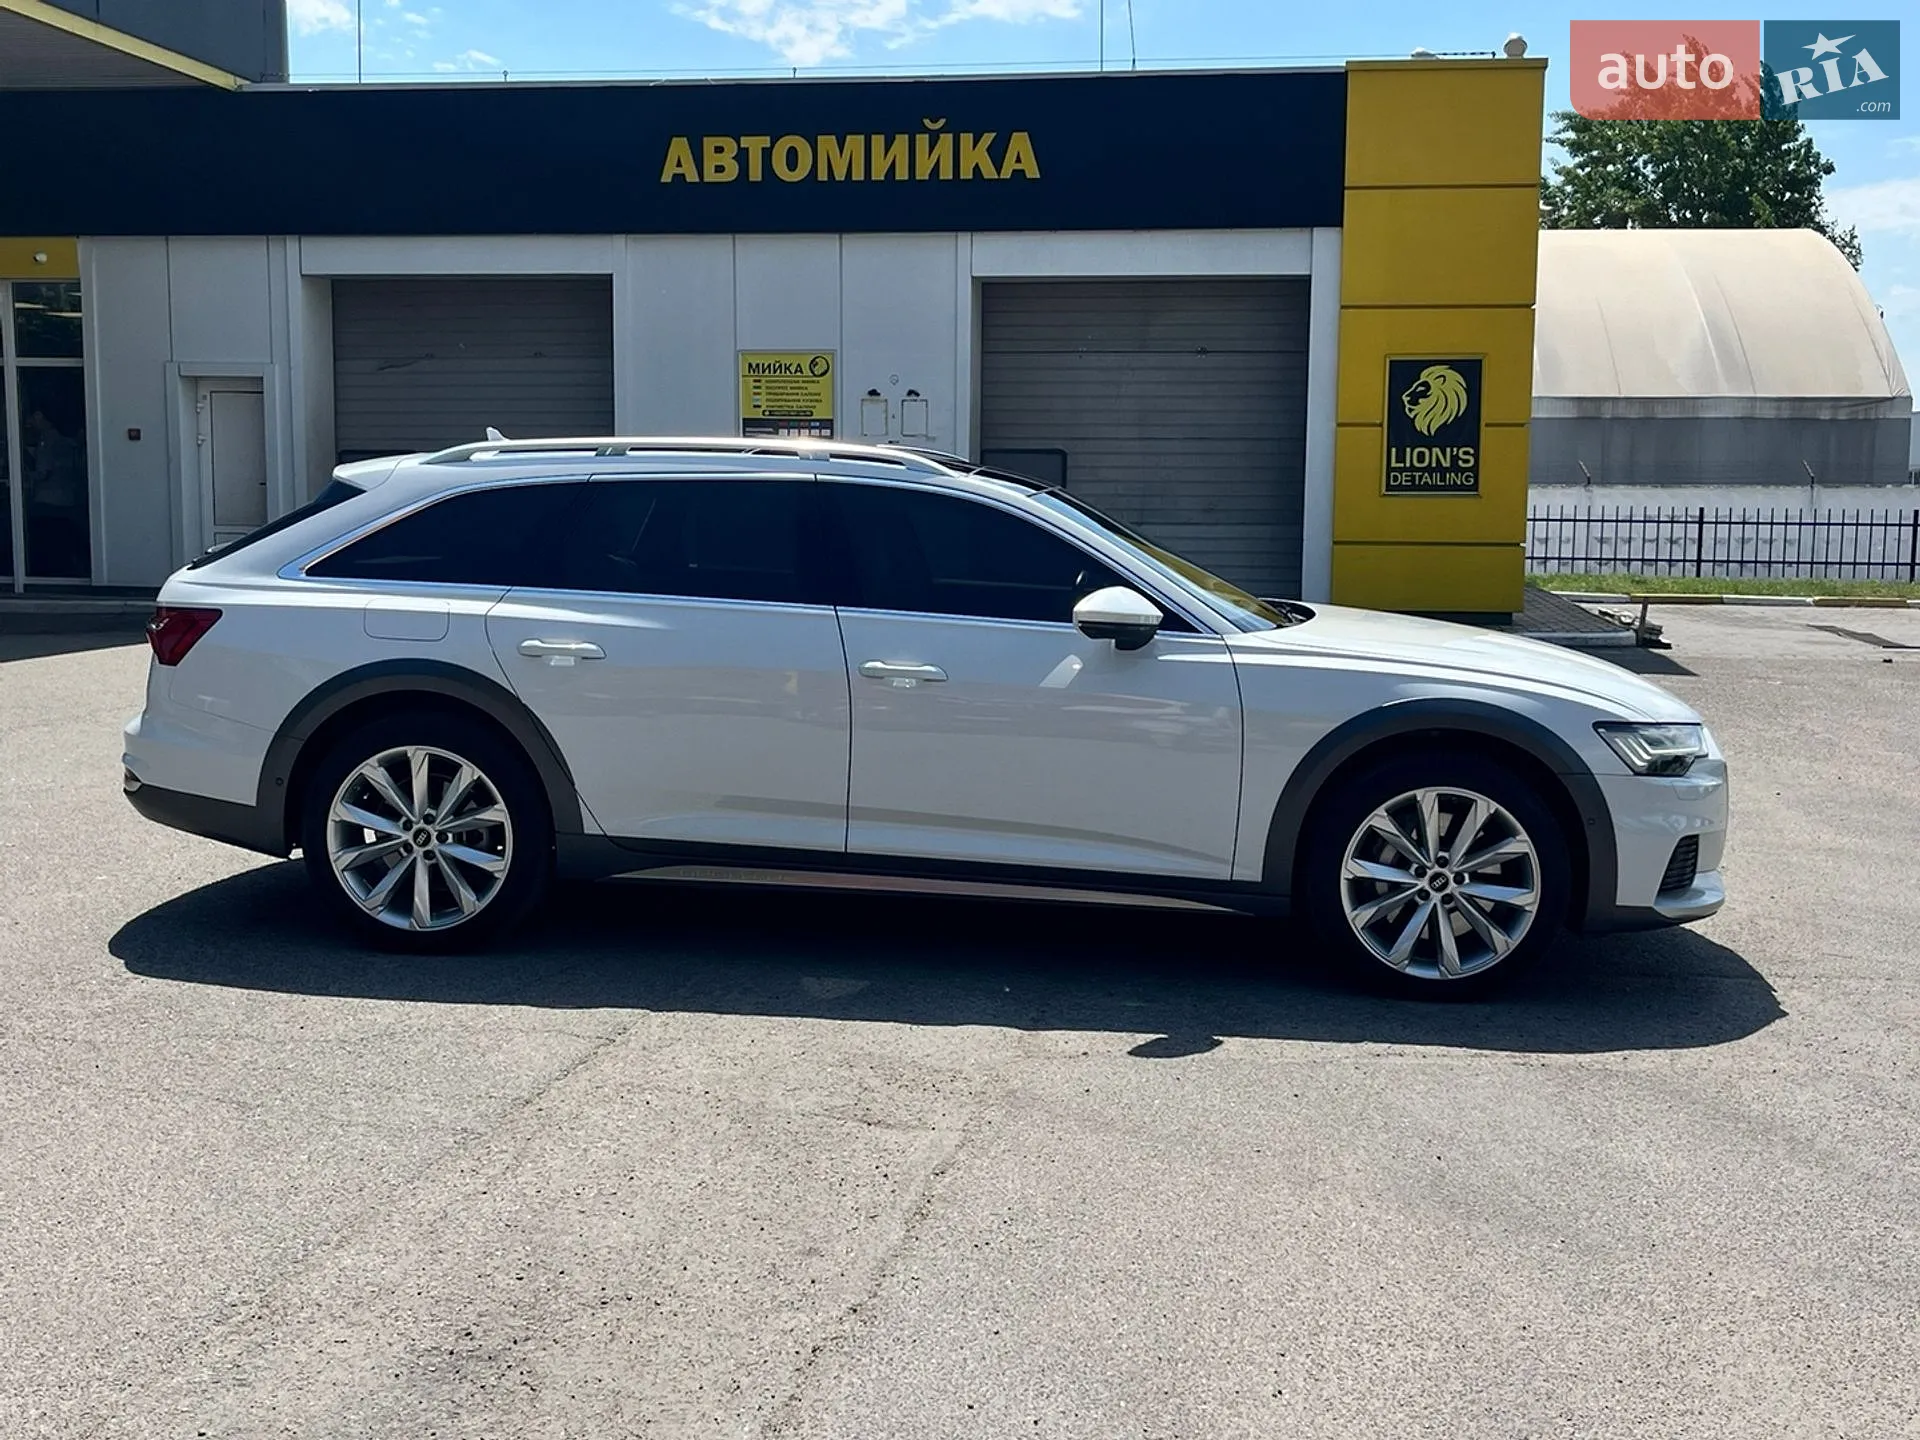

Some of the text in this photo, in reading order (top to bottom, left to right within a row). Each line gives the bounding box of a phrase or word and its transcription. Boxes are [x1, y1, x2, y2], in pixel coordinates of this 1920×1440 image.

[660, 118, 1041, 183] АВТОМИЙКА
[747, 360, 804, 375] МИЙКА
[1391, 447, 1475, 467] LION'S
[1390, 472, 1475, 486] DETAILING
